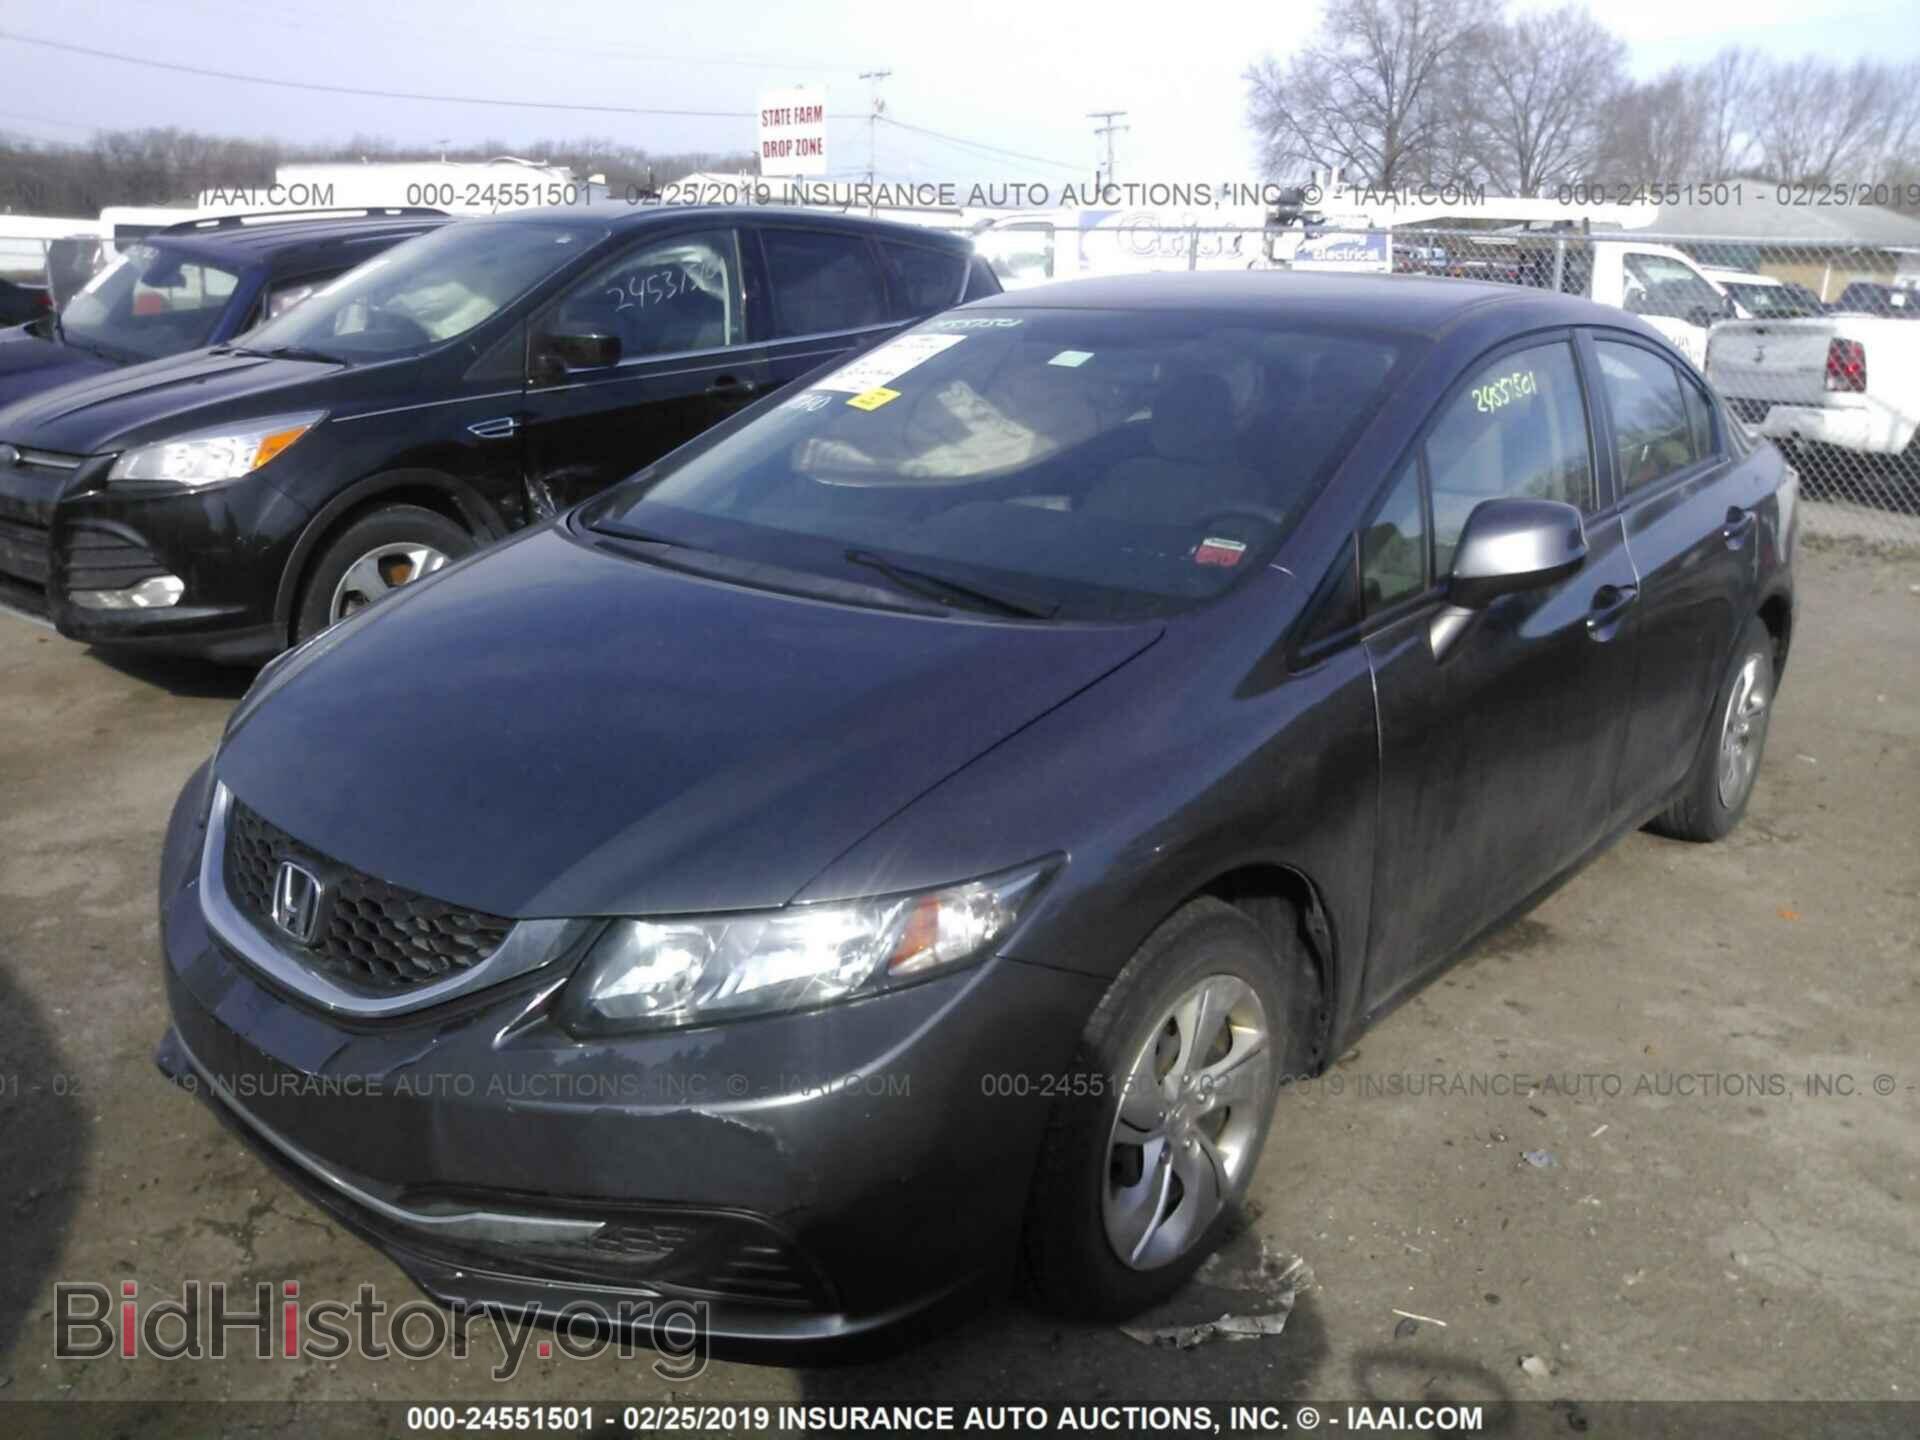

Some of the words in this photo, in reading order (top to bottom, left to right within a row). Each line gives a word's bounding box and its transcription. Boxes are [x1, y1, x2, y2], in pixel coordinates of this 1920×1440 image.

[761, 108, 791, 127] STATE
[794, 105, 822, 125] FARM
[763, 140, 792, 158] DROP
[796, 137, 823, 156] ZONE
